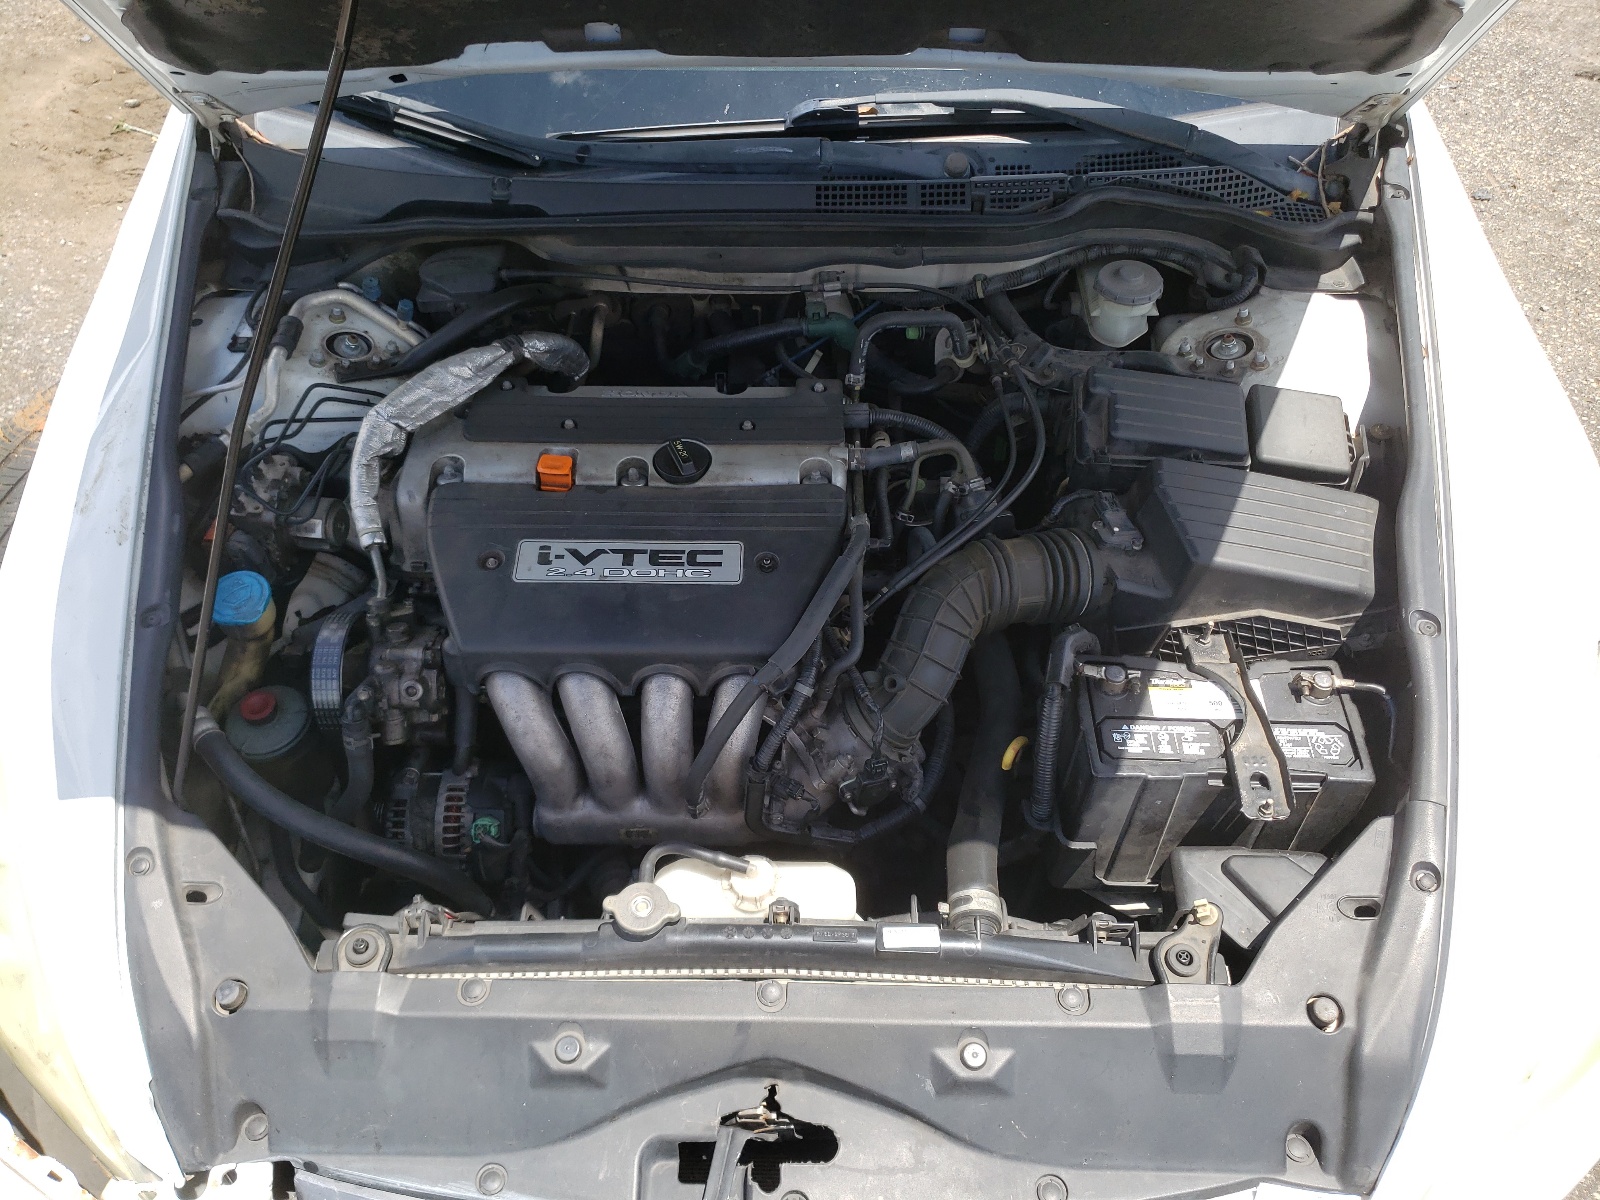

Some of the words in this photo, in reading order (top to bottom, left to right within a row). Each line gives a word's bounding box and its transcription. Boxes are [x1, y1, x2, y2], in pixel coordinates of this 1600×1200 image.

[537, 545, 724, 567] i-VTEC
[546, 567, 596, 577] 2.4
[603, 568, 712, 578] DOHC
